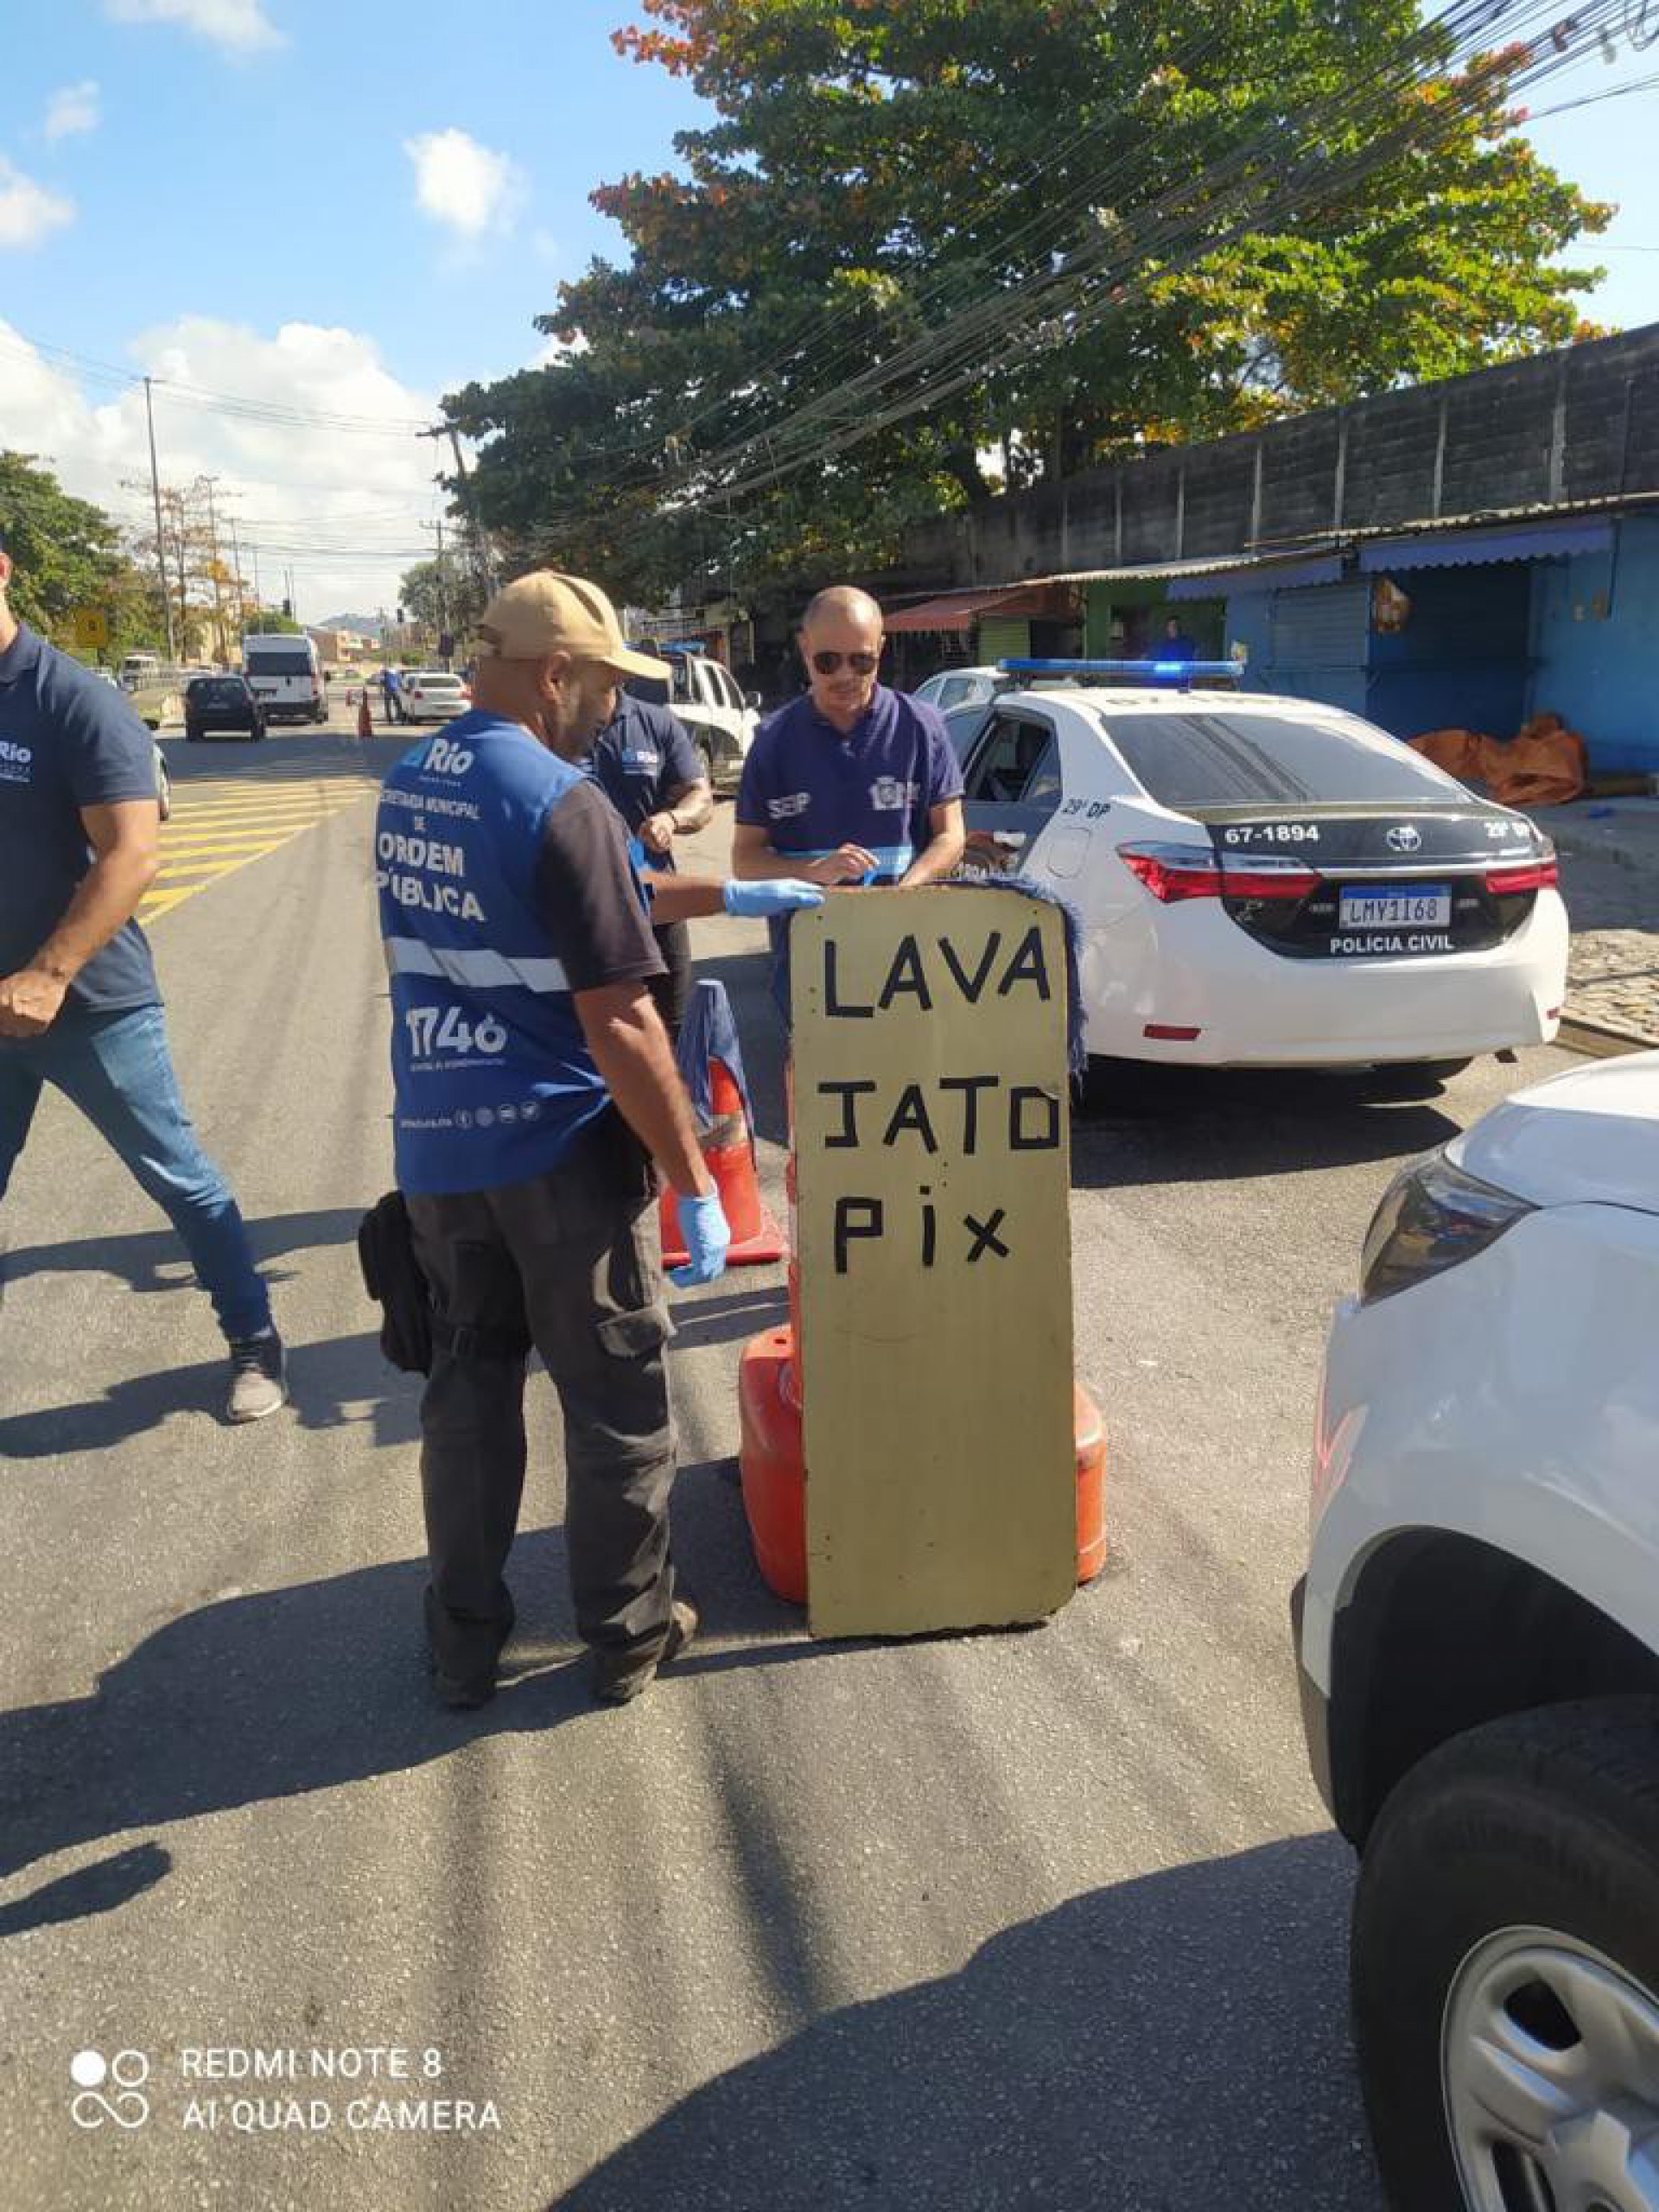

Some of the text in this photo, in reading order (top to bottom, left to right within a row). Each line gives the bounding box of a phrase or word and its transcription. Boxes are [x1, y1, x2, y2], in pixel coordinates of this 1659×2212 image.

[423, 738, 474, 773] Rio
[378, 831, 464, 877] ORDEM
[1225, 825, 1320, 843] 67-1894
[1408, 934, 1455, 950] CIVIL
[824, 926, 1051, 1017] LAVA
[817, 1076, 1060, 1155] JATO
